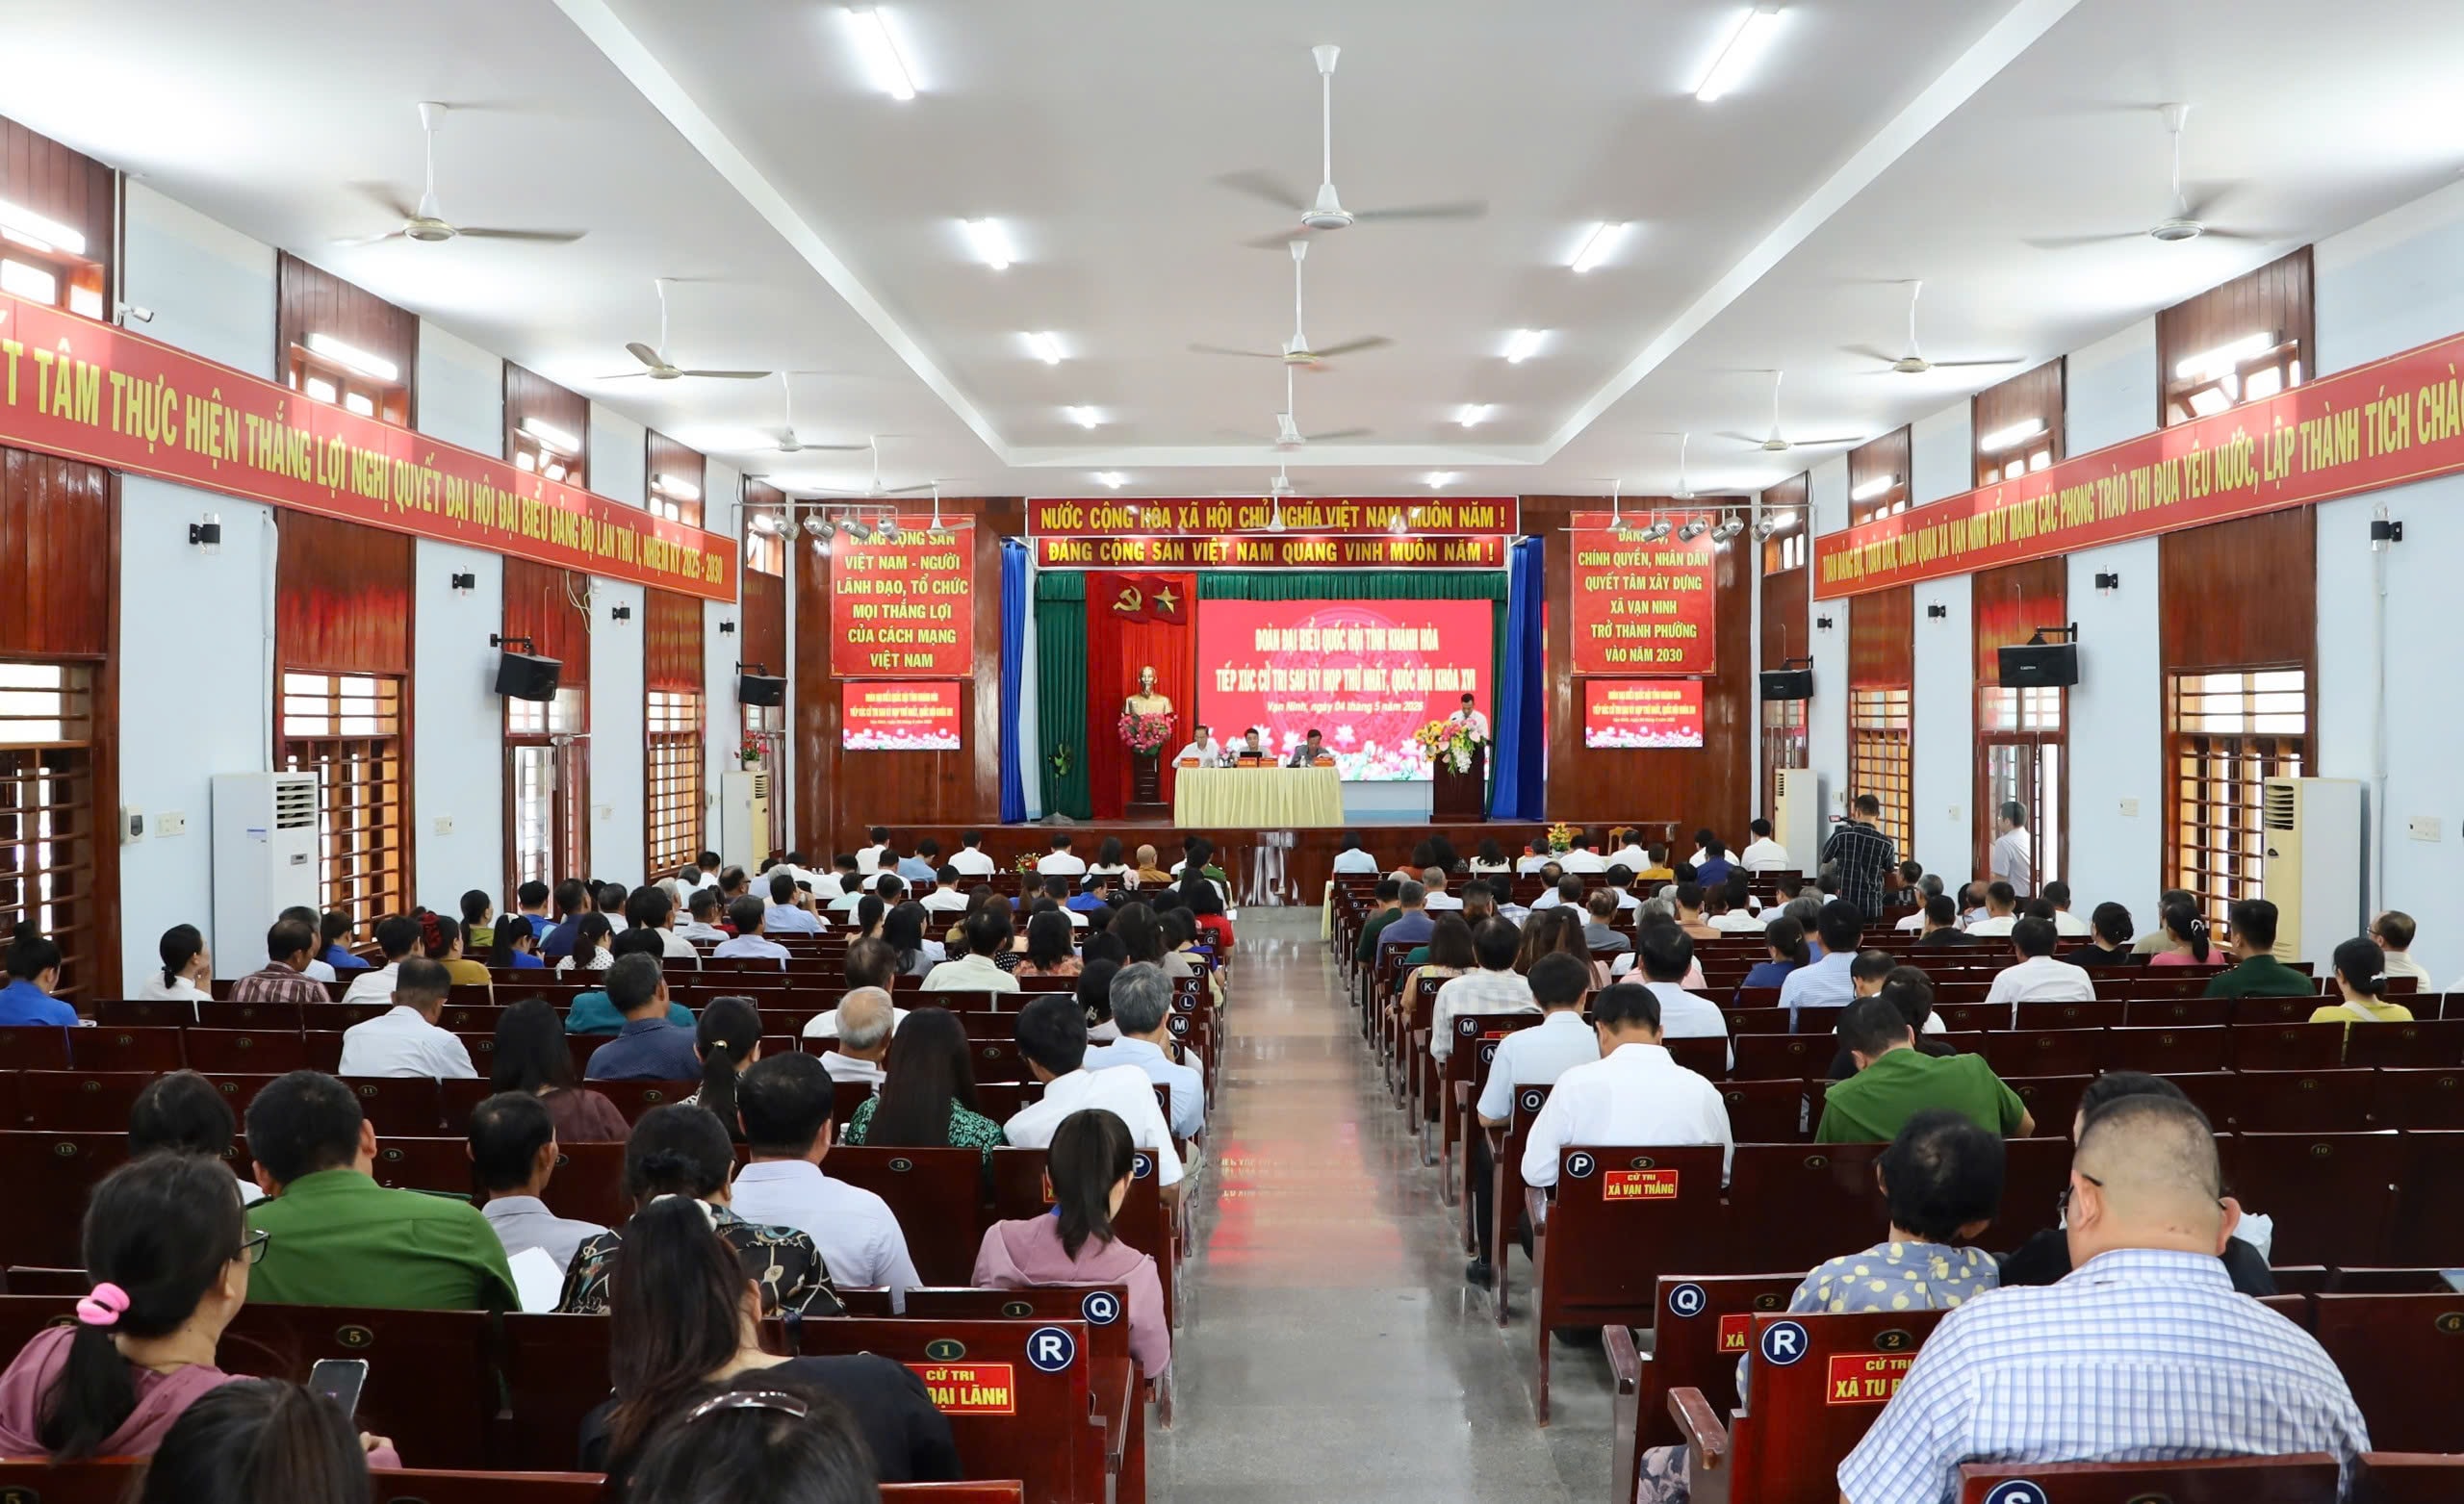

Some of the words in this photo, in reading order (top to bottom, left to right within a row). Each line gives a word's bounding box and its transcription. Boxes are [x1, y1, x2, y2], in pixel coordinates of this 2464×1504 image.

[34, 338, 100, 426] TÂM
[110, 371, 177, 454] THỰC
[186, 388, 239, 470] HIỆN
[245, 400, 311, 482] THẮNG
[318, 434, 346, 497] LỢI
[351, 446, 389, 512] NGHỊ
[394, 452, 441, 514] QUYẾT
[446, 474, 468, 528] ĐẠI
[473, 476, 495, 534] HỘI
[499, 492, 519, 540] ĐẠI
[523, 482, 548, 542] BIỂU
[551, 494, 578, 549] ĐẢNG
[581, 508, 594, 560] BỘ
[617, 521, 634, 563] THỨ
[682, 546, 700, 579] 2025
[1899, 523, 1916, 567] TOÀN
[1917, 518, 1938, 568] QUÂN
[1938, 515, 1948, 558] XÃ
[1950, 517, 1966, 562] VẠN
[1969, 512, 1987, 551] NINH
[1989, 488, 2007, 546] ĐẨY
[2010, 499, 2036, 548] MẠNH
[2039, 483, 2057, 534] CÁC
[2060, 483, 2094, 529] PHONG
[2097, 464, 2128, 521] TRÀO
[2130, 466, 2150, 513] THI
[2154, 458, 2180, 507] ĐUA
[2184, 439, 2210, 499] YÊU
[2215, 425, 2258, 495] NƯỚC,
[2264, 415, 2296, 489] LẬP
[2300, 401, 2359, 473] THÀNH
[2365, 385, 2410, 457] TÍCH
[2417, 363, 2464, 445] CHÀ
[1040, 501, 1083, 529] NƯỚC
[1091, 501, 1133, 533] CỘNG
[1141, 501, 1171, 529] HÒA
[1178, 501, 1200, 528] XÃ
[1206, 500, 1232, 533] HỘI
[1239, 498, 1270, 528] CHỦ
[1326, 500, 1360, 532] VIỆT
[1366, 506, 1401, 528] NAM
[1407, 500, 1452, 528] MUÔN
[1459, 501, 1494, 528] NĂM
[1099, 538, 1144, 566] CỘNG
[1193, 537, 1230, 566] VIỆT
[1236, 542, 1274, 562] NAM
[1282, 542, 1337, 565] QUANG
[1345, 542, 1383, 562] VINH
[1390, 538, 1437, 562] MUÔN
[1444, 539, 1480, 562] NĂM
[1578, 549, 1610, 566] CHÍNH
[1655, 549, 1683, 566] NHÂN
[1687, 549, 1708, 566] DÂN
[845, 552, 874, 573] VIỆT
[879, 555, 908, 570] NAM
[920, 552, 960, 570] NGƯỜI
[836, 577, 871, 595] LÃNH
[876, 580, 907, 597] ĐẠO,
[911, 574, 929, 595] TỔ
[933, 577, 968, 595] CHỨC
[1585, 572, 1620, 592] QUYẾT
[1623, 574, 1646, 590] TÂM
[1649, 574, 1670, 590] XÂY
[1673, 575, 1703, 592] DỰNG
[853, 604, 878, 621] MỌI
[882, 599, 926, 619] THẮNG
[930, 604, 951, 621] LỢI
[1610, 598, 1625, 614] XÃ
[1628, 600, 1650, 617] VẠN
[1652, 600, 1677, 614] NINH
[848, 624, 875, 643] CỦA
[878, 625, 913, 643] CÁCH
[918, 628, 956, 646] MẠNG
[1299, 616, 1321, 651] BIỂU
[1322, 619, 1346, 654] QUỐC
[1590, 619, 1613, 638] TRỞ
[1615, 621, 1651, 638] THÀNH
[1654, 621, 1697, 638] PHƯỜNG
[870, 650, 900, 670] VIỆT
[904, 653, 934, 668] NAM
[1604, 645, 1627, 662] VÀO
[1630, 646, 1653, 662] NĂM
[1656, 648, 1683, 662] 2030
[1216, 660, 1237, 692] TIẾP
[1238, 663, 1256, 692] XÚC
[1272, 669, 1287, 692] TRI
[1289, 669, 1306, 692] SAU
[1392, 659, 1416, 696] QUỐC
[1461, 669, 1476, 691] XVI
[1334, 701, 1346, 711] 04
[1348, 701, 1373, 714] tháng
[1374, 701, 1380, 711] 5
[1381, 701, 1401, 711] năm
[1184, 998, 1192, 1007] L
[1174, 1020, 1185, 1031] M
[1463, 1023, 1474, 1032] M
[1526, 1095, 1539, 1108] O
[1135, 1158, 1144, 1172] P
[1574, 1158, 1587, 1172] P
[1608, 1183, 1621, 1195] XÃ
[1623, 1184, 1641, 1196] VẠN
[1644, 1180, 1674, 1195] THẮNG
[1091, 1298, 1112, 1318] Q
[1678, 1289, 1698, 1311] Q
[1039, 1336, 1064, 1362] R
[1726, 1331, 1745, 1347] XÃ
[1773, 1330, 1796, 1355] R
[926, 1367, 948, 1381] CỬ
[951, 1370, 974, 1381] TRI
[1865, 1357, 1886, 1371] CỬ
[1889, 1359, 1912, 1369] TRI
[961, 1384, 1007, 1405] LÃNH
[1835, 1376, 1859, 1397] XÃ
[1864, 1379, 1886, 1396] TU
